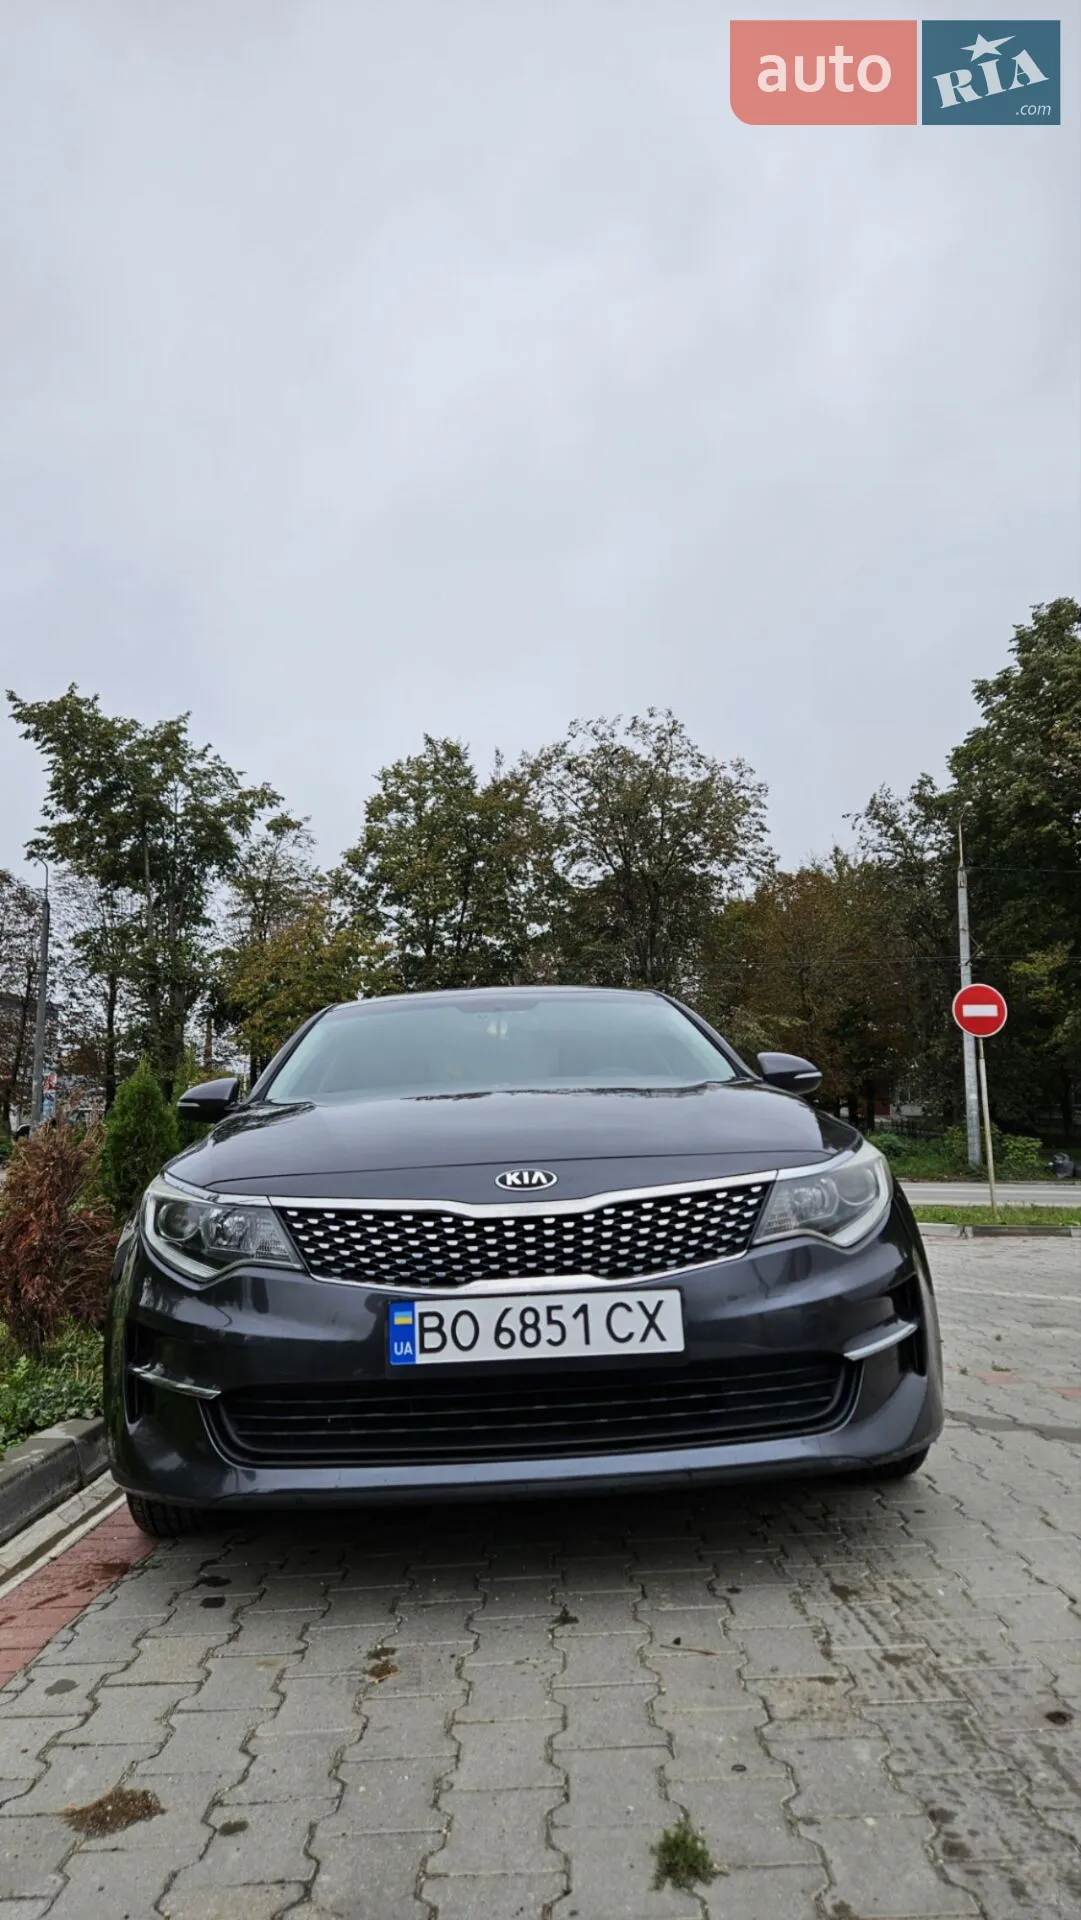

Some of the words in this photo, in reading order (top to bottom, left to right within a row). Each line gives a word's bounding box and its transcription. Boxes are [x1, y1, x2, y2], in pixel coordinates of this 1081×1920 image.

[505, 1171, 548, 1186] KIA
[418, 1310, 480, 1354] BO
[494, 1303, 591, 1350] 6851
[605, 1300, 667, 1344] CX
[393, 1342, 413, 1356] UA
